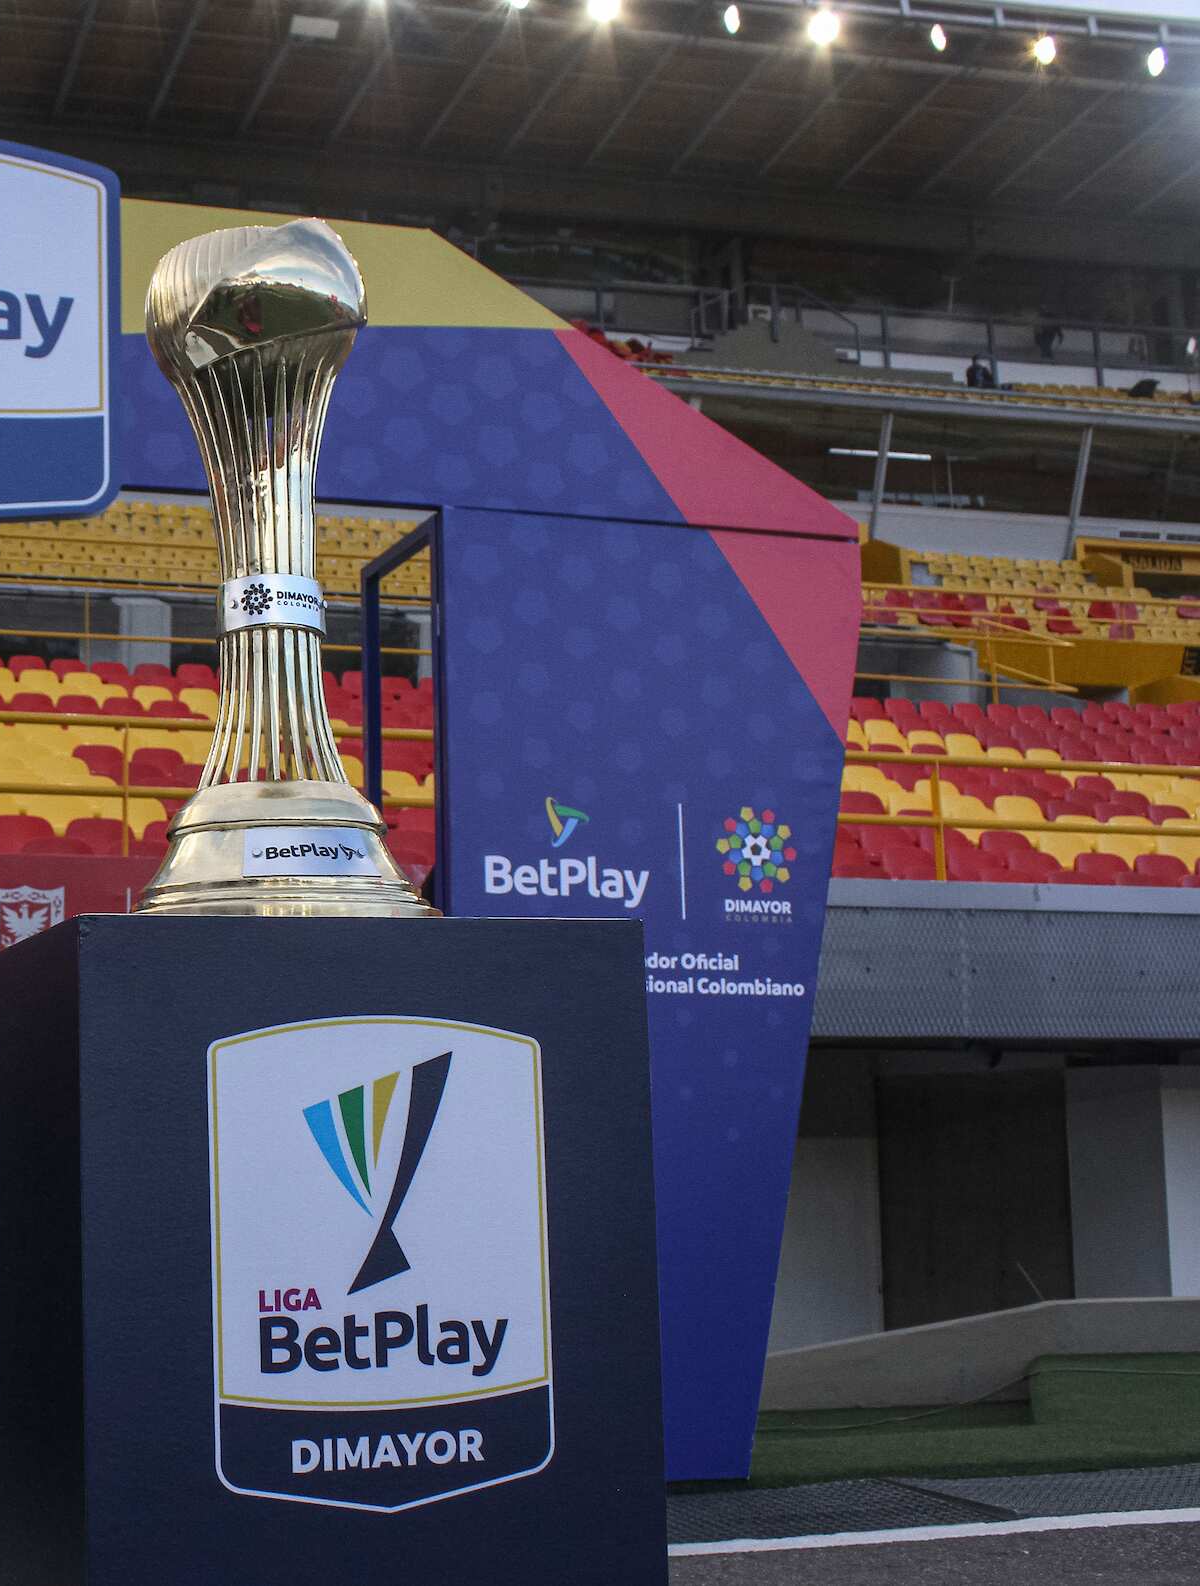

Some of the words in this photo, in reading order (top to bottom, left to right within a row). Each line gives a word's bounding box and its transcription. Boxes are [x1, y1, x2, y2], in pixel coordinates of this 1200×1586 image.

[276, 591, 320, 607] DIMAYOR
[277, 601, 319, 612] COLOMBIA
[265, 843, 339, 860] BetPlay
[484, 855, 649, 908] BetPlay
[725, 899, 792, 915] DIMAYOR
[725, 914, 793, 923] COLOMBIA
[645, 952, 678, 969] dor
[681, 952, 740, 971] Oficial
[697, 977, 805, 996] Colombiano
[259, 1287, 322, 1313] LIGA
[259, 1304, 509, 1376] BetPlay
[291, 1430, 485, 1474] DIMAYOR
